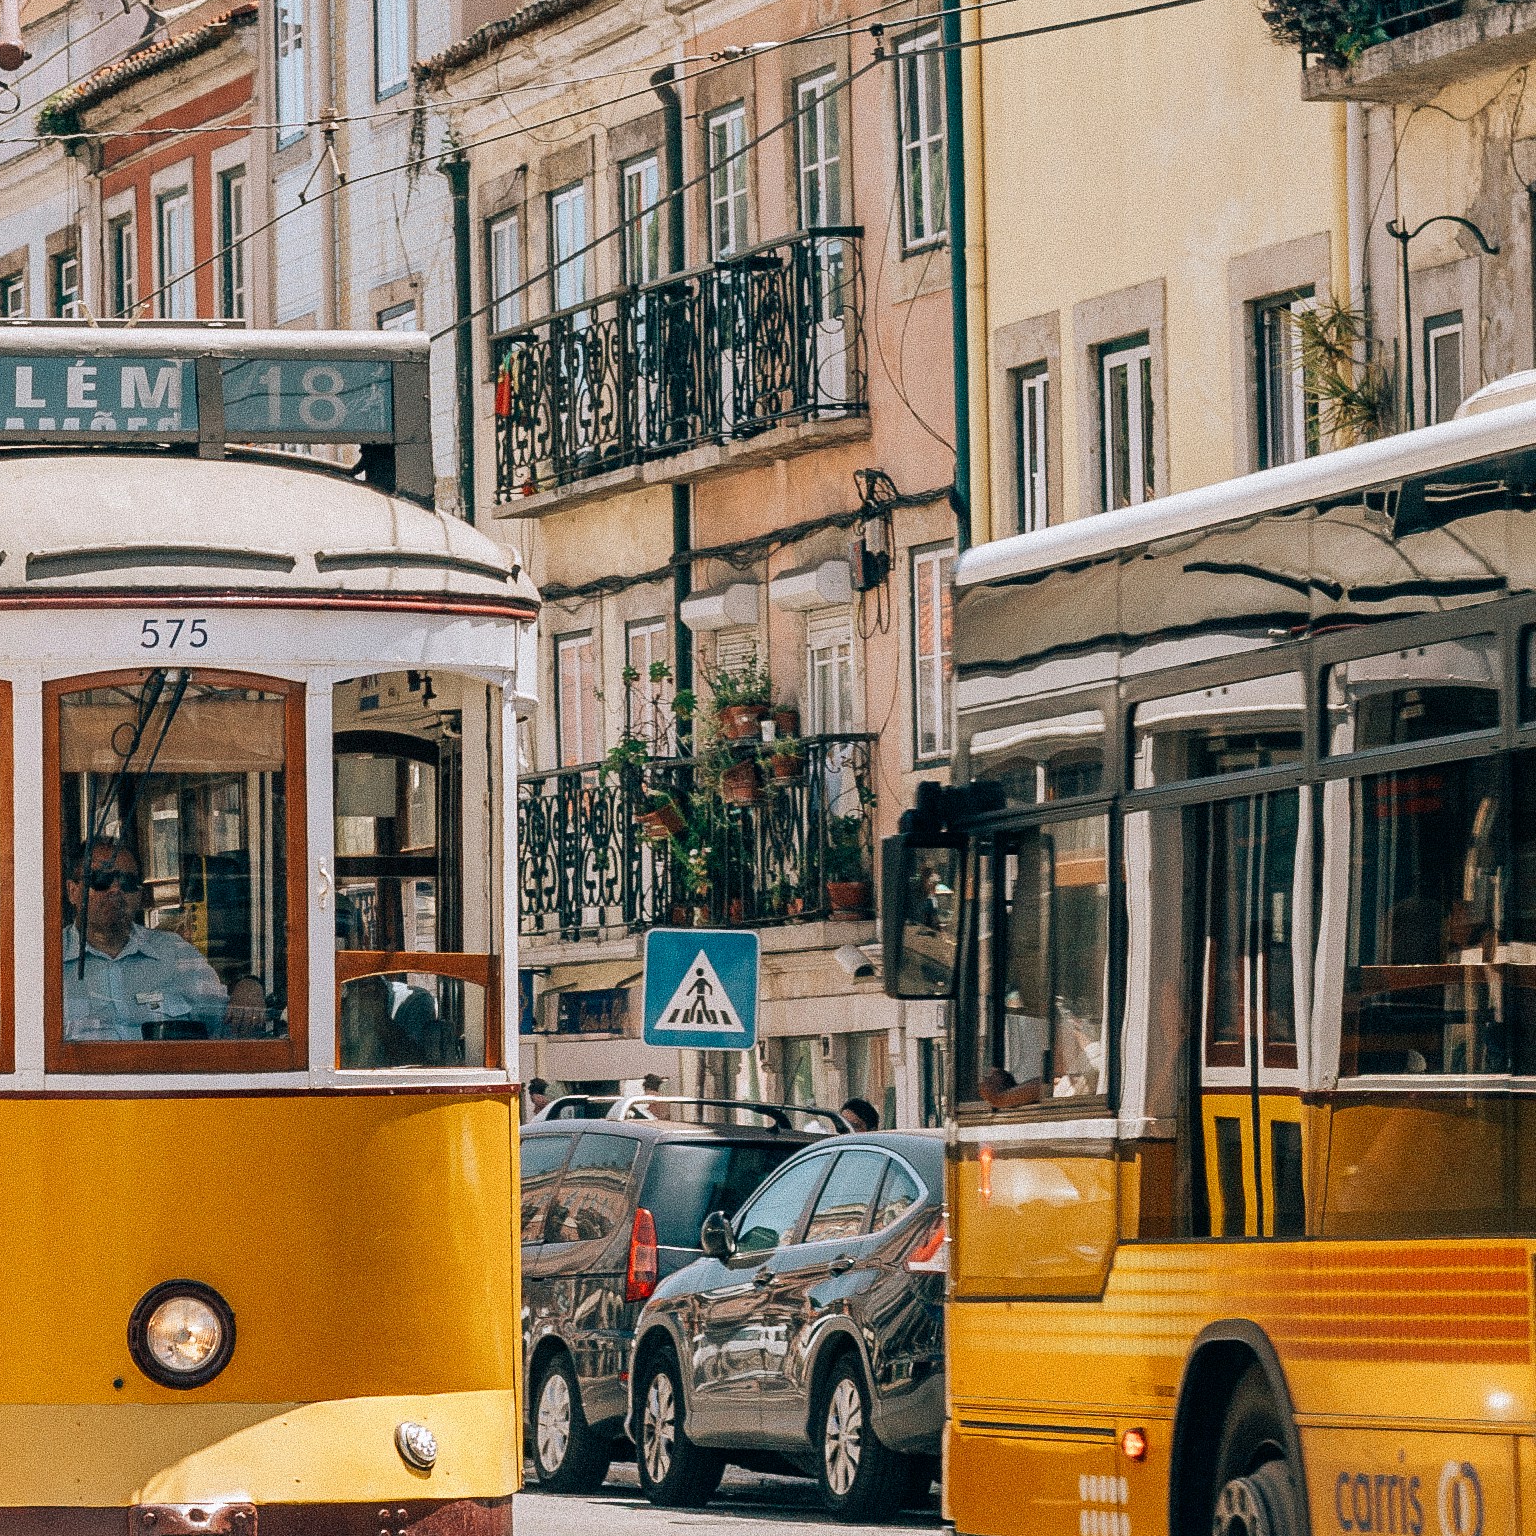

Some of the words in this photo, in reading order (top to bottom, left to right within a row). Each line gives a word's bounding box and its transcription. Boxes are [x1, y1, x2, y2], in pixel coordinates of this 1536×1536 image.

[259, 365, 347, 430] 18
[140, 618, 209, 649] 575
[1335, 1448, 1424, 1536] carris
